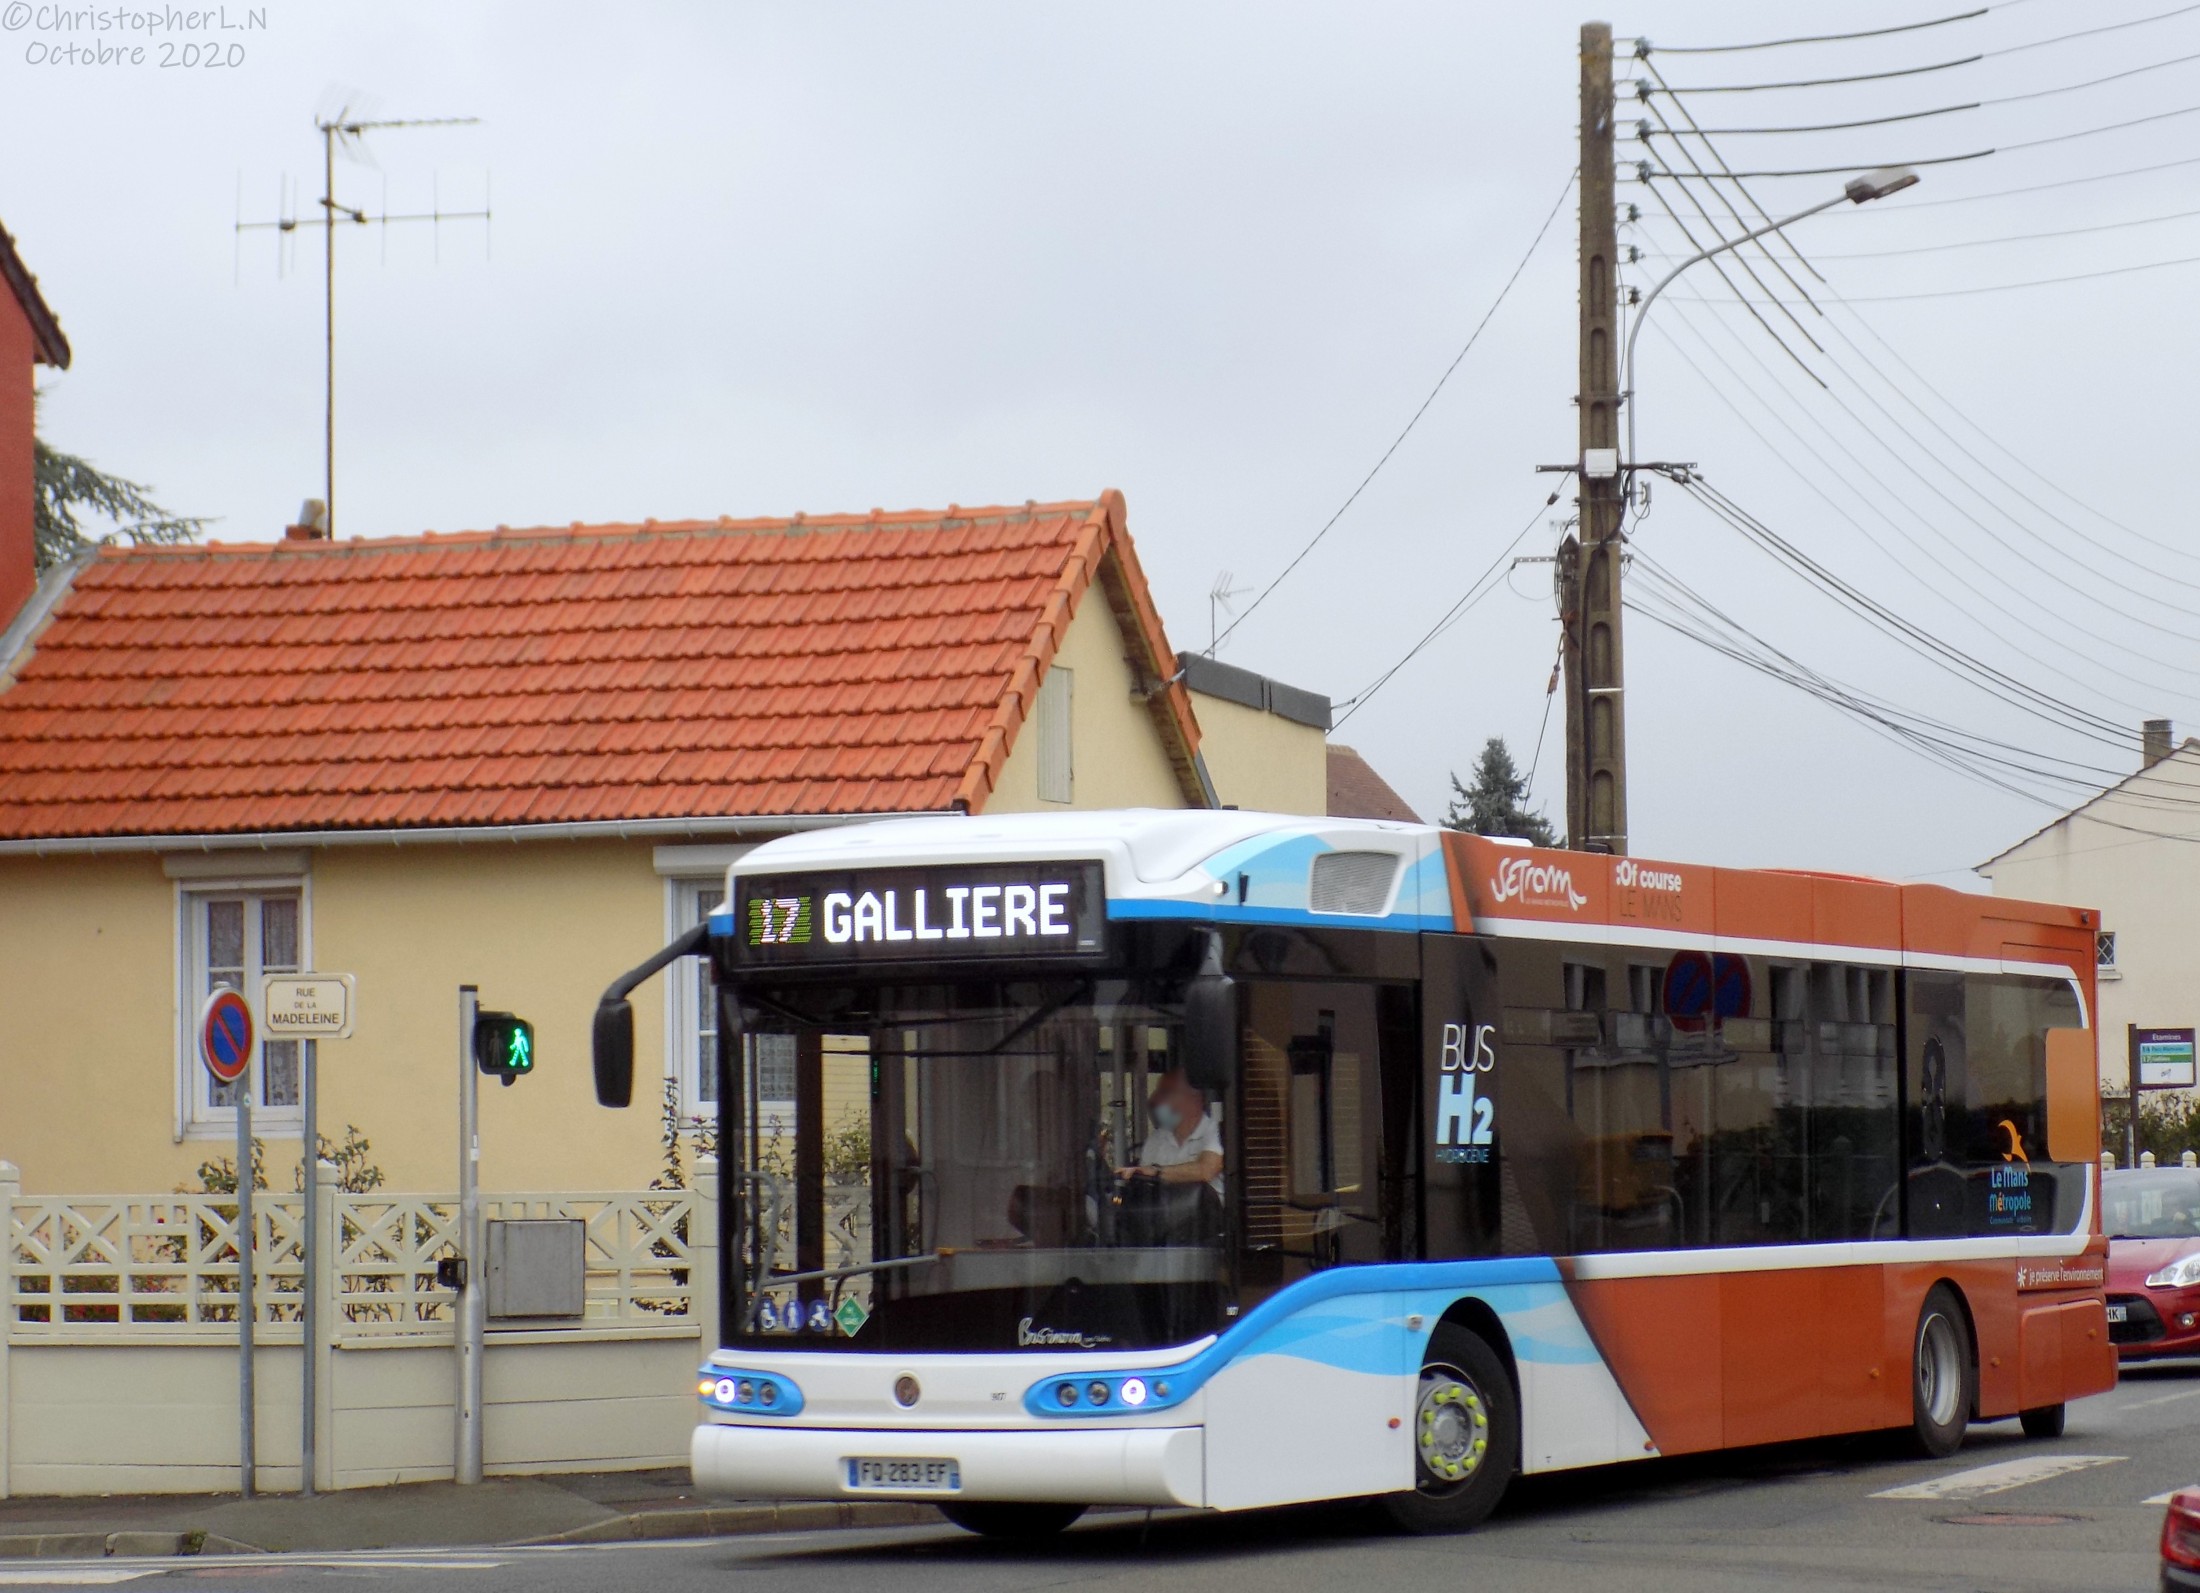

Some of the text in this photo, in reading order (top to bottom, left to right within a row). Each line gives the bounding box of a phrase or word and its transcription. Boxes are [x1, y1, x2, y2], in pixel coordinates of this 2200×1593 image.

[1640, 870, 1683, 892] course
[823, 884, 1070, 943] GALLIERE
[1619, 889, 1683, 922] LE MANS
[295, 987, 316, 998] RUE
[294, 1001, 317, 1009] DE LA
[272, 1013, 340, 1025] MADELEINE
[1440, 1023, 1496, 1073] BUS
[1436, 1072, 1495, 1145] H2
[1991, 1166, 2030, 1189] Le Mans
[1989, 1191, 2032, 1217] Métropole
[2029, 1268, 2036, 1286] je
[2036, 1267, 2060, 1286] préserve
